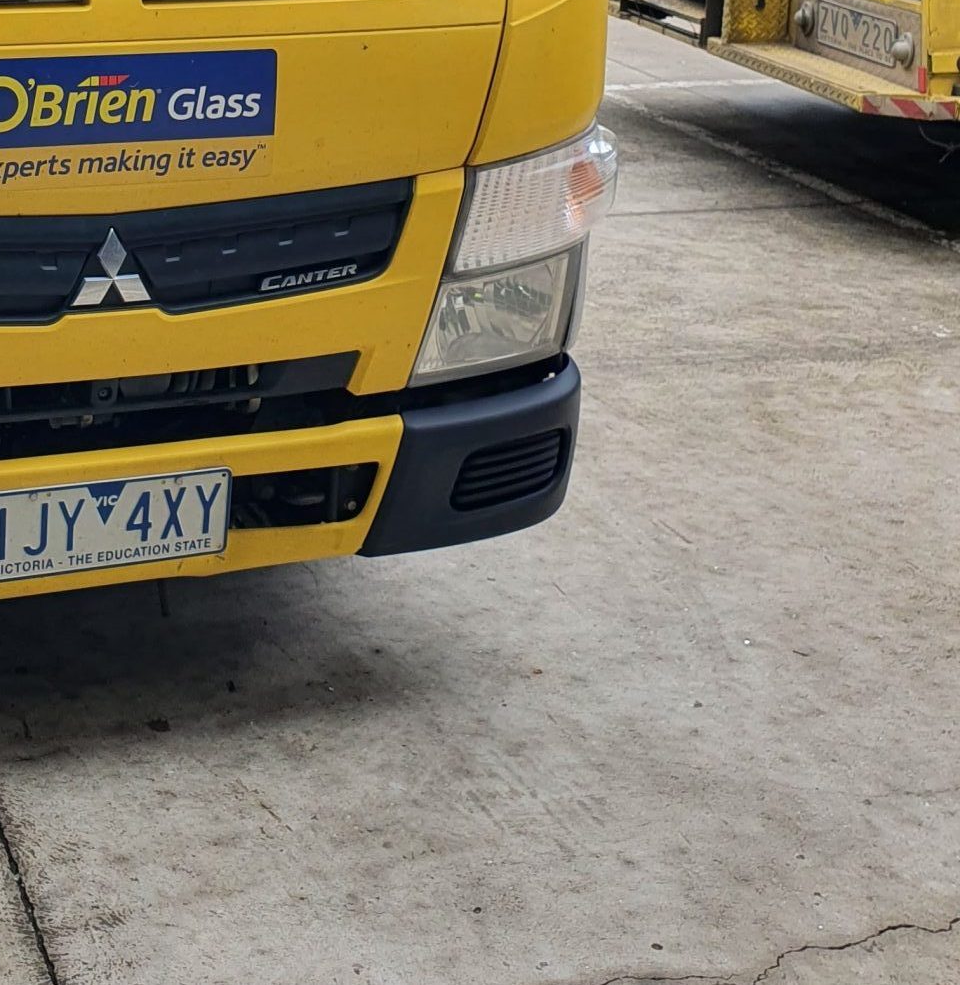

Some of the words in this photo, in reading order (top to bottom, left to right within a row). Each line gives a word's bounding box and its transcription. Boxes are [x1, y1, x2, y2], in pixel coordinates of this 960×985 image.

[861, 19, 894, 54] 220
[167, 85, 262, 121] Glass
[77, 149, 171, 177] making
[177, 147, 197, 169] it
[260, 264, 358, 291] CANTER
[90, 494, 118, 507] VIC
[126, 482, 222, 542] 4XY
[68, 553, 93, 566] THE
[97, 541, 170, 563] EDUCATION
[174, 537, 212, 552] STATE
